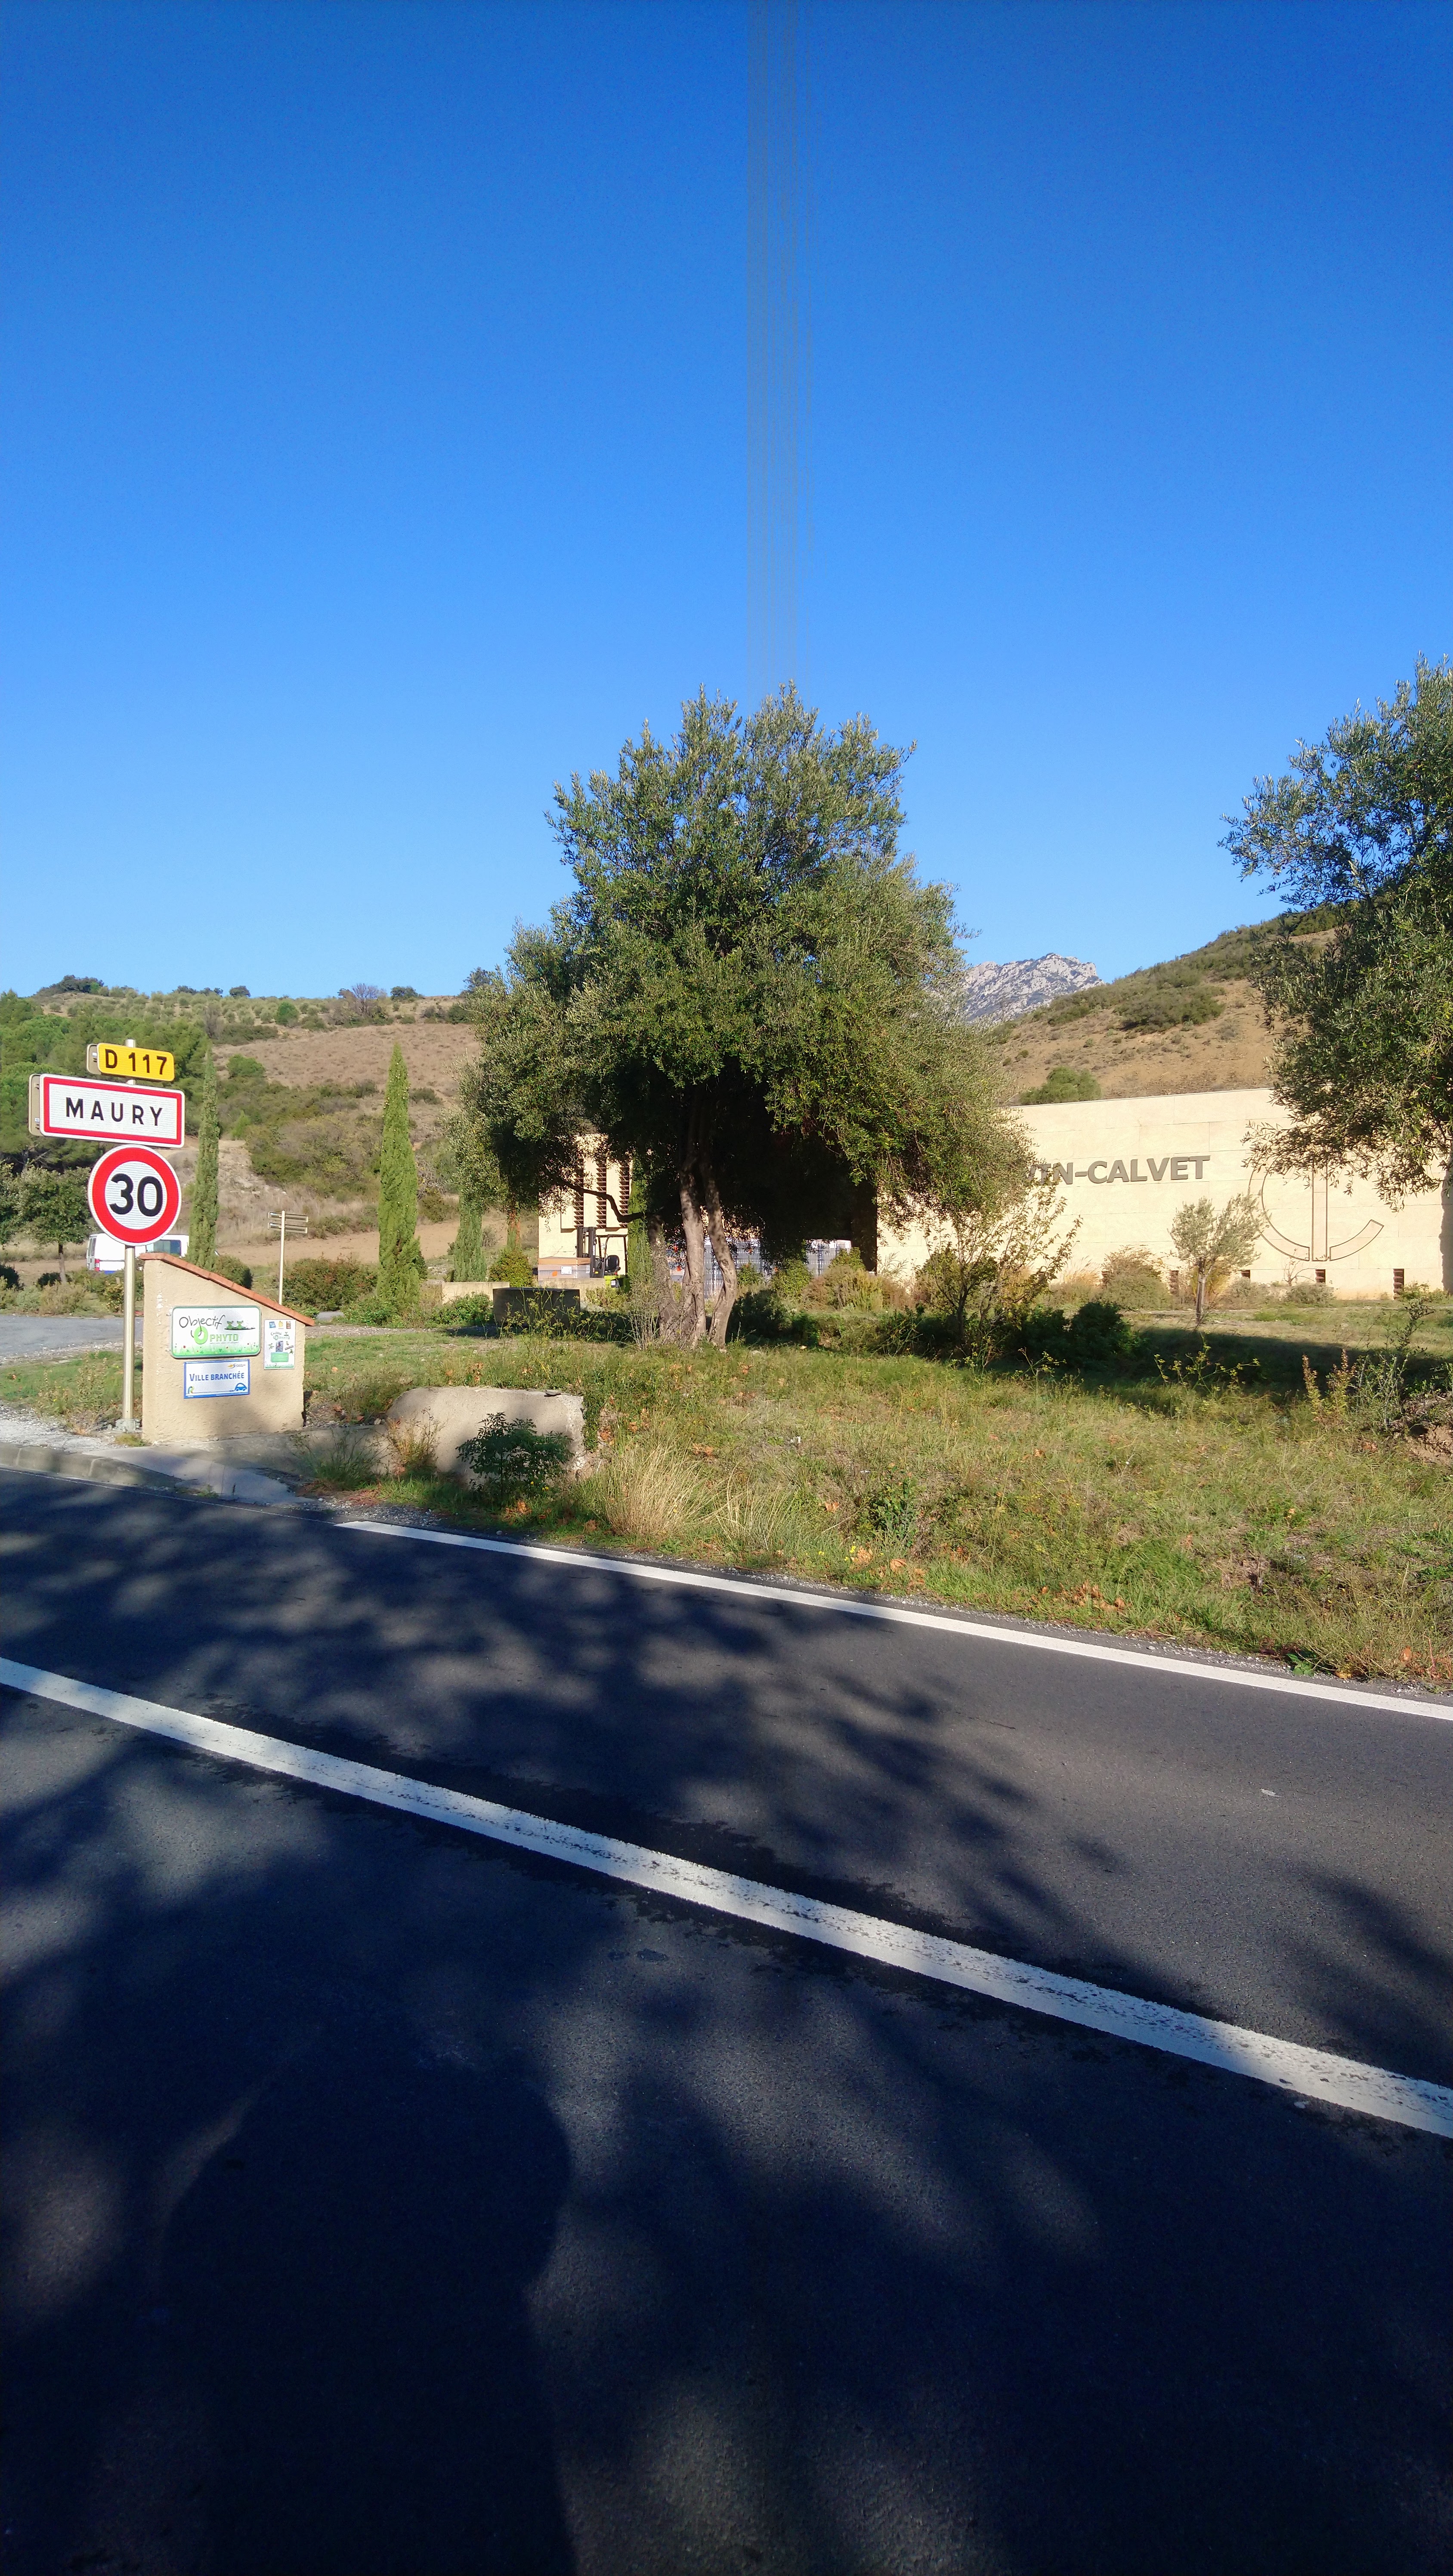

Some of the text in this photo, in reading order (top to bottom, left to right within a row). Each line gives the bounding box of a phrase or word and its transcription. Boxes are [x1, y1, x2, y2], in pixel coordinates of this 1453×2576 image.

[105, 1049, 167, 1075] D 117
[66, 1097, 163, 1126] MAURY
[109, 1173, 164, 1217] 30
[179, 1315, 226, 1338] Objectif
[210, 1334, 239, 1342] PHYTO
[210, 1371, 244, 1380] BRANCHÉE
